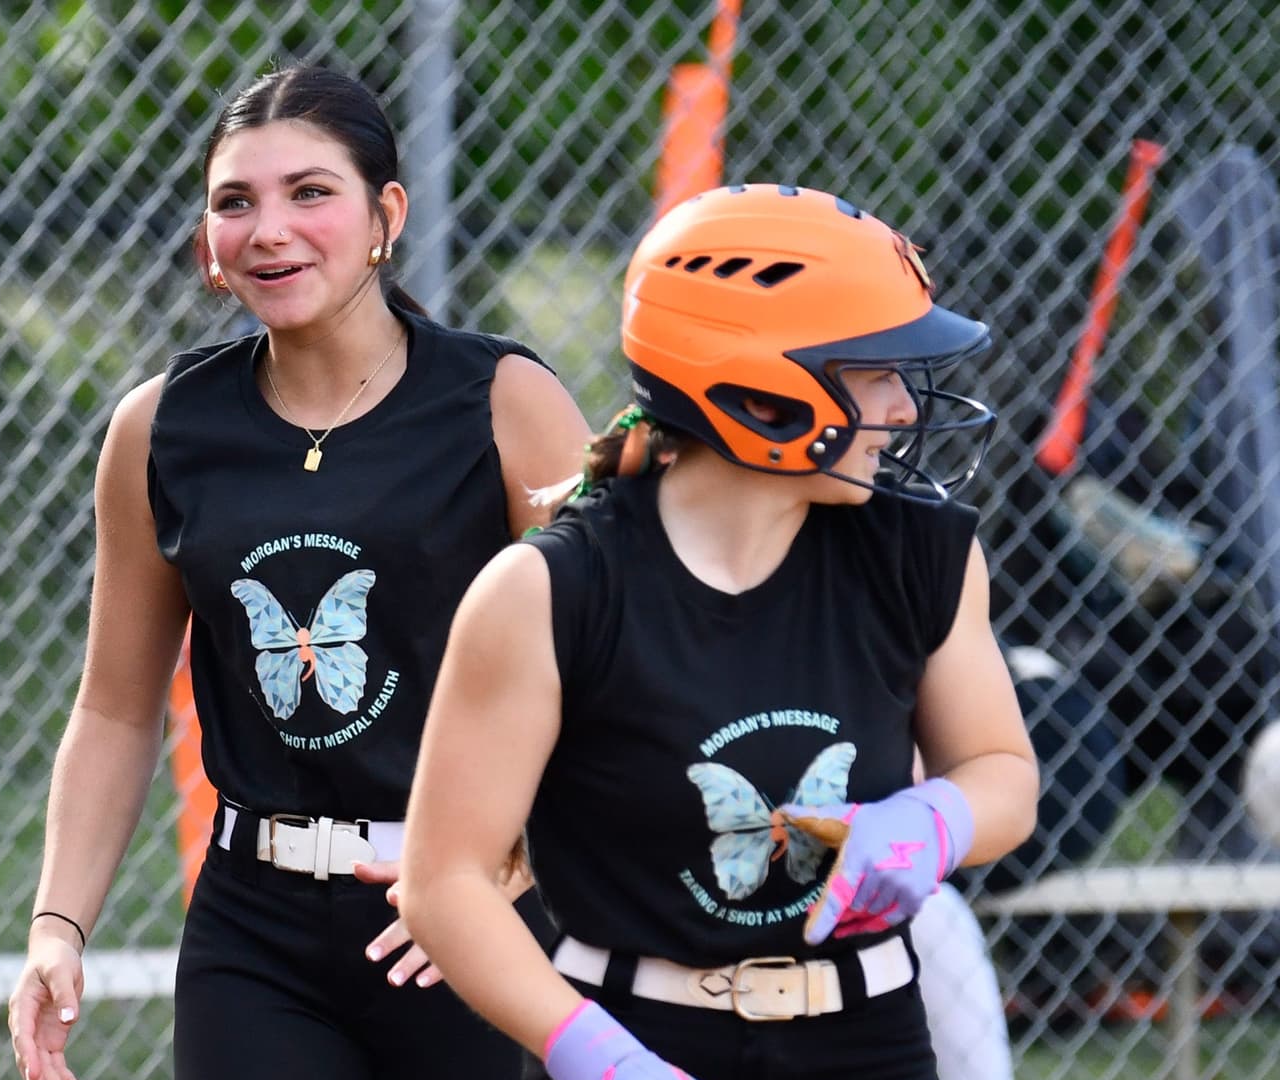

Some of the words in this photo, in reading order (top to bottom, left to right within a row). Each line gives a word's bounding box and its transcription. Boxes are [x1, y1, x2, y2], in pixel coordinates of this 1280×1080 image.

[240, 535, 301, 573] MORGAN'S
[304, 533, 362, 560] MESSAGE
[309, 737, 322, 750] AT
[323, 715, 373, 748] MENTAL
[367, 669, 400, 718] HEALTH
[699, 712, 771, 758] MORGAN'S
[771, 709, 841, 735] MESSAGE
[679, 868, 719, 915] TAKING
[715, 907, 727, 920] A
[727, 908, 764, 927] SHOT
[765, 908, 783, 924] AT
